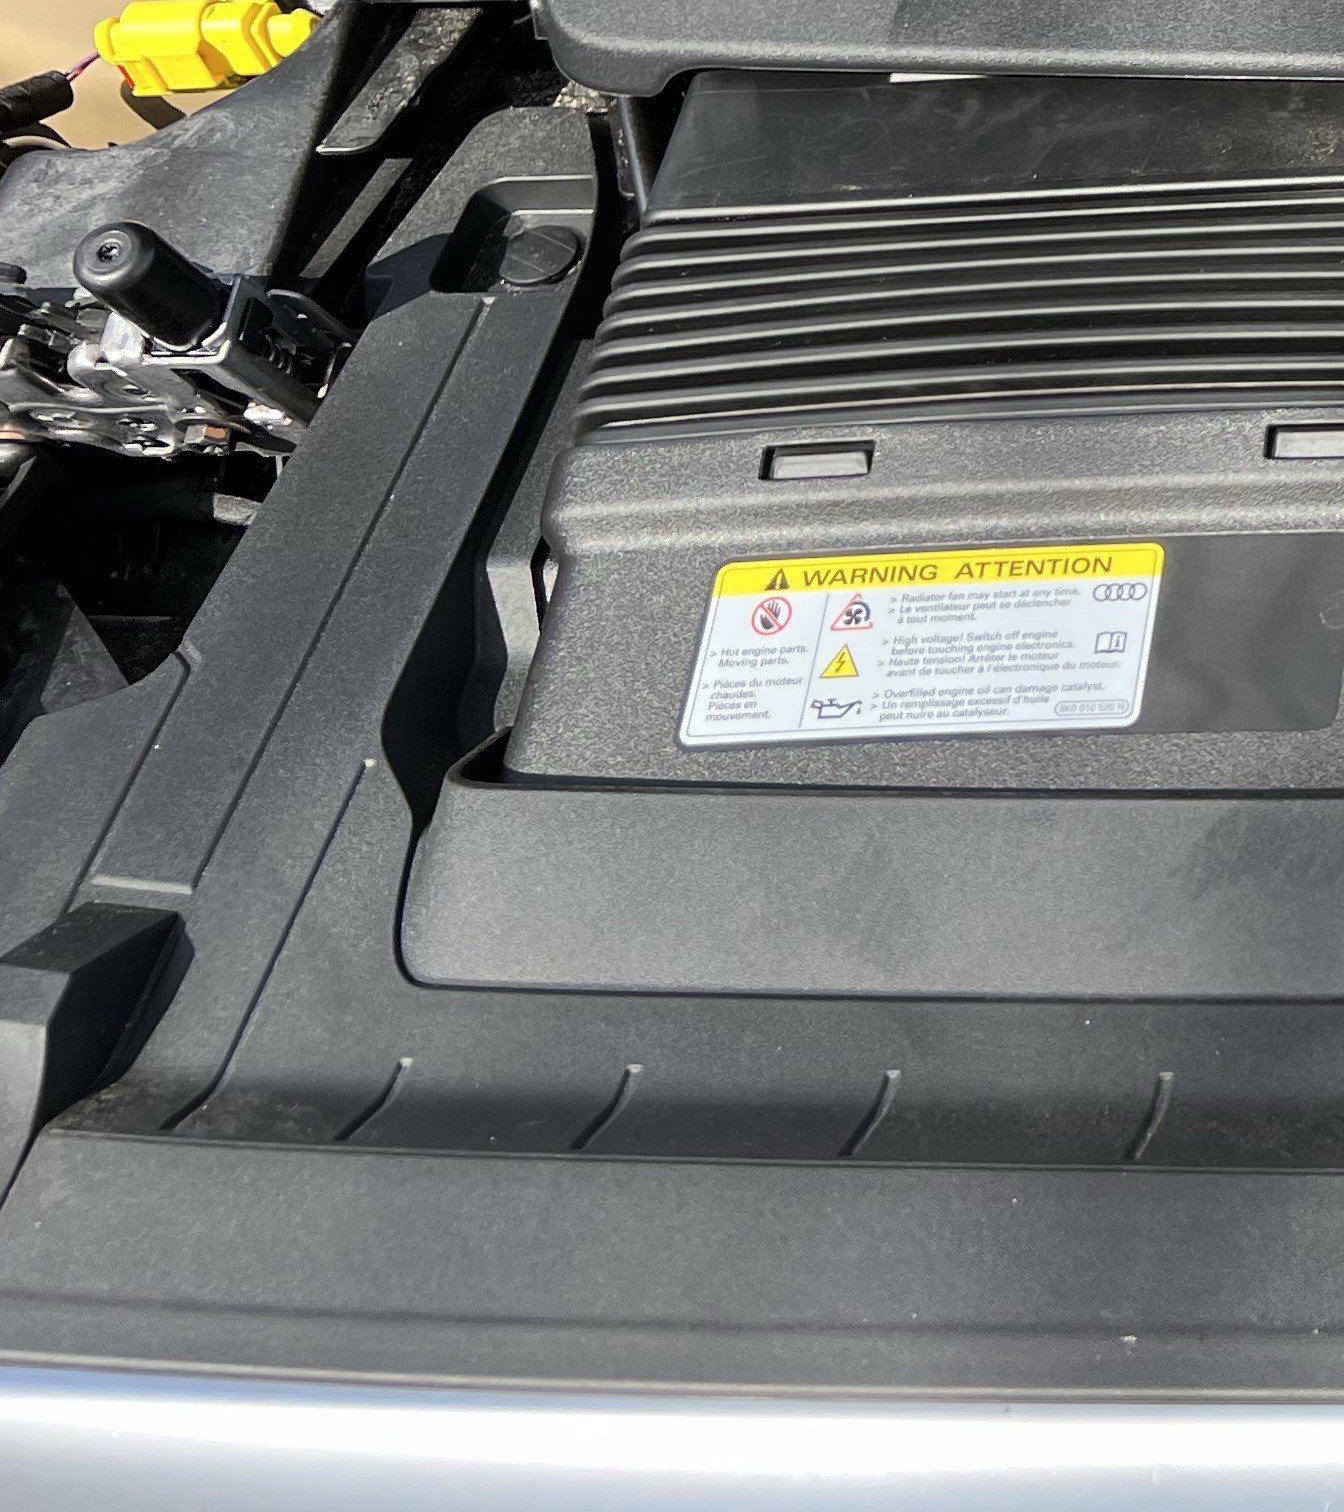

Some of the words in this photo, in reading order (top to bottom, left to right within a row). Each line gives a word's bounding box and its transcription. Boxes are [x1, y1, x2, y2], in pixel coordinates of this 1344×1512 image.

[803, 564, 938, 587] WARNING
[954, 556, 1112, 579] ATTENTION
[902, 592, 945, 603] Radiator
[948, 591, 964, 601] fan
[967, 591, 990, 602] may
[993, 590, 1017, 599] start
[1019, 589, 1029, 598] at
[1032, 589, 1051, 599] any
[899, 605, 911, 614] Le
[915, 602, 970, 613] ventilateur
[973, 600, 996, 612] peut
[999, 600, 1011, 609] se
[907, 613, 927, 623] tout
[893, 635, 919, 647] High
[966, 631, 1002, 642] Switch
[1004, 630, 1020, 640] off
[1021, 630, 1058, 641] engine
[721, 647, 739, 657] Hot
[742, 646, 777, 657] engine
[891, 645, 925, 656] before
[928, 643, 974, 655] touching
[976, 642, 1013, 653] engine
[719, 657, 757, 668] Moving
[889, 655, 920, 666] Haute
[1008, 651, 1017, 661] le
[1020, 651, 1060, 661] moteur
[886, 667, 916, 677] avant
[919, 666, 932, 676] de
[935, 664, 975, 675] toucher
[1062, 660, 1076, 670] du
[749, 677, 762, 687] du
[765, 676, 803, 686] moteur
[883, 687, 936, 698] Overfilled
[938, 687, 974, 698] engine
[977, 684, 990, 695] oil
[993, 685, 1011, 694] can
[1014, 683, 1058, 695] damage
[744, 700, 757, 709] en
[882, 700, 897, 710] Un
[901, 698, 965, 710] remplissage
[967, 695, 1011, 705] excessif
[879, 711, 903, 722] peut
[906, 709, 933, 719] nuire
[936, 709, 950, 719] au
